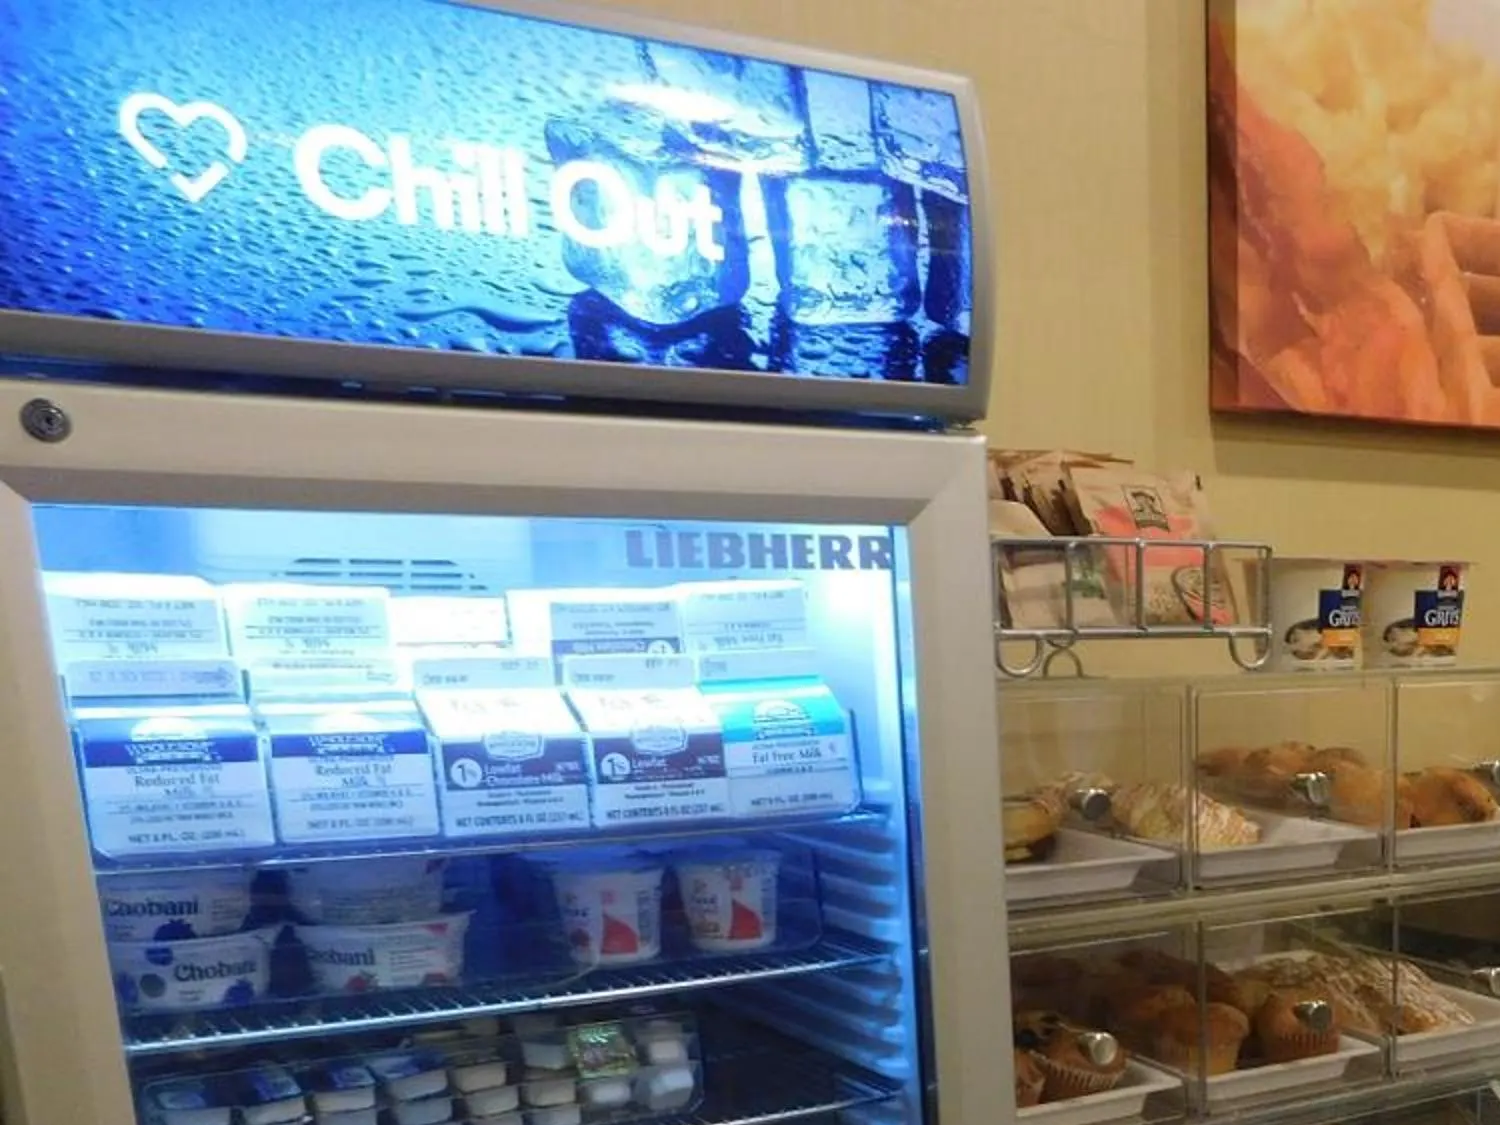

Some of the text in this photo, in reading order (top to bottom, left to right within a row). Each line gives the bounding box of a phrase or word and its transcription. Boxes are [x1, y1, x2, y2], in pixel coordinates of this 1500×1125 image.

[295, 124, 726, 261] Chill Out
[625, 530, 893, 570] LIEBHERR
